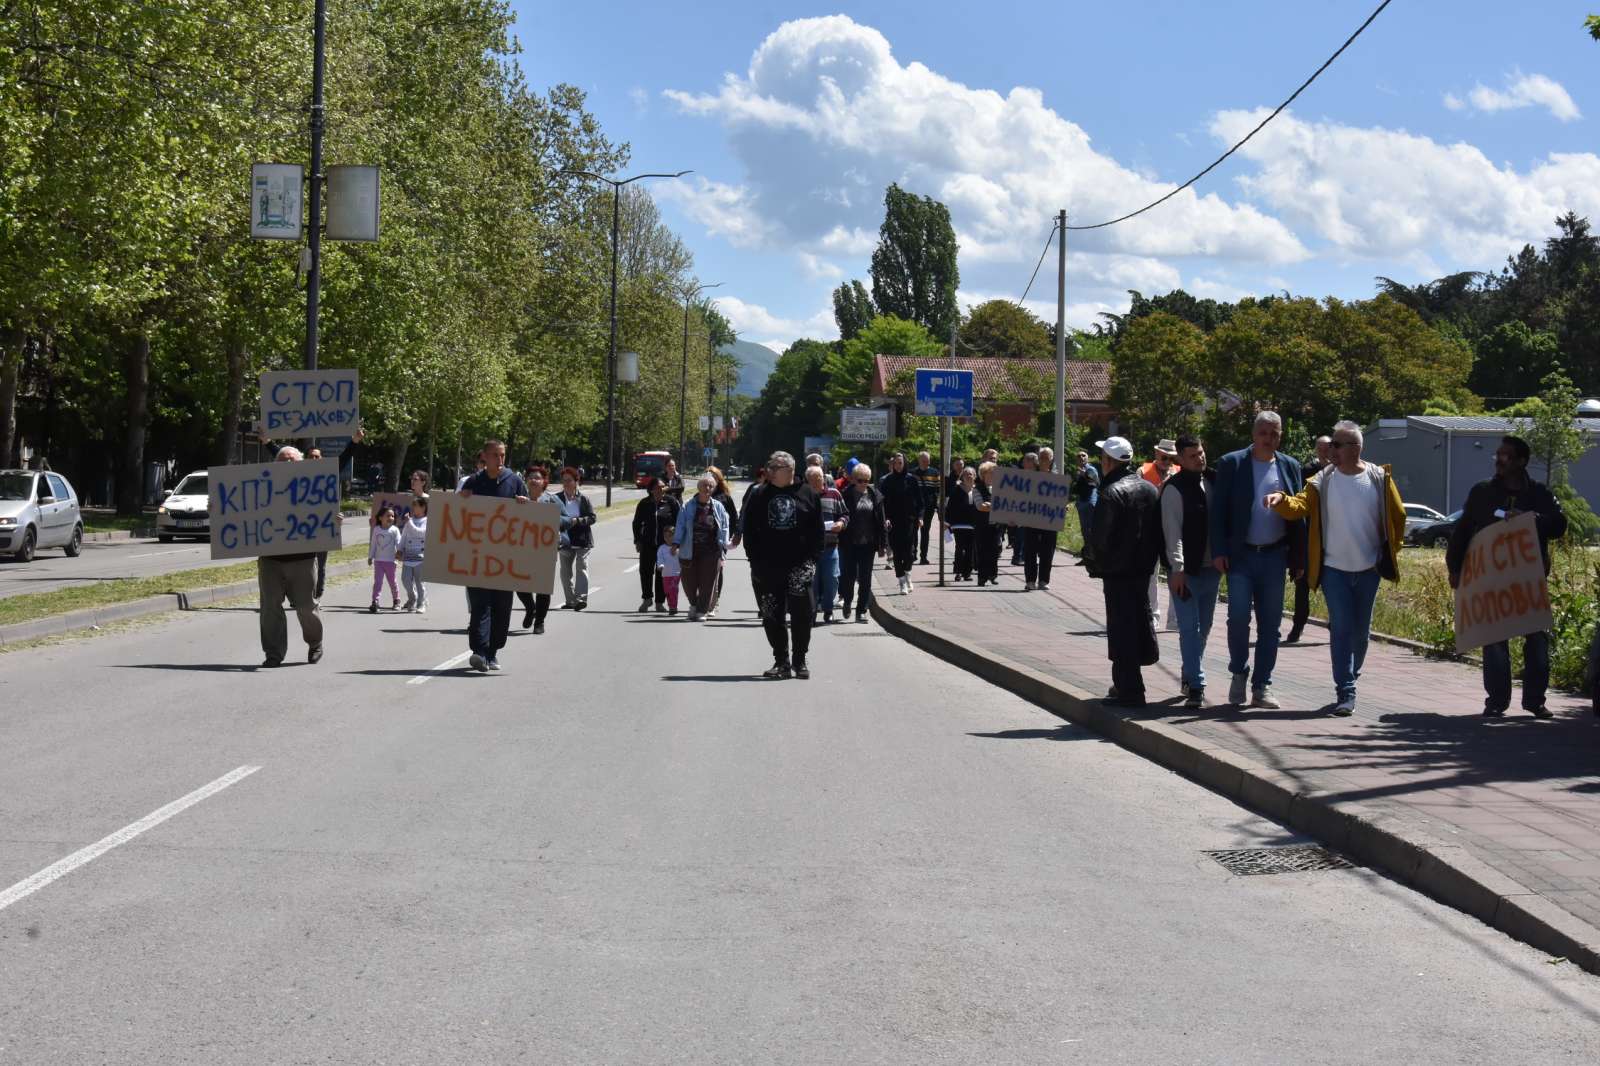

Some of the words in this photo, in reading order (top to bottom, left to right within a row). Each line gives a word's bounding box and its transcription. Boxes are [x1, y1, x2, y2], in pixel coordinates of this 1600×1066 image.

[271, 380, 354, 407] СТОП
[999, 473, 1032, 494] МИ
[1037, 480, 1068, 498] СМО
[440, 503, 556, 551] NEĆEMO
[1462, 544, 1486, 588] ВИ
[1491, 527, 1537, 571] СТЕ
[1459, 580, 1549, 635] ЛОПОВИ
